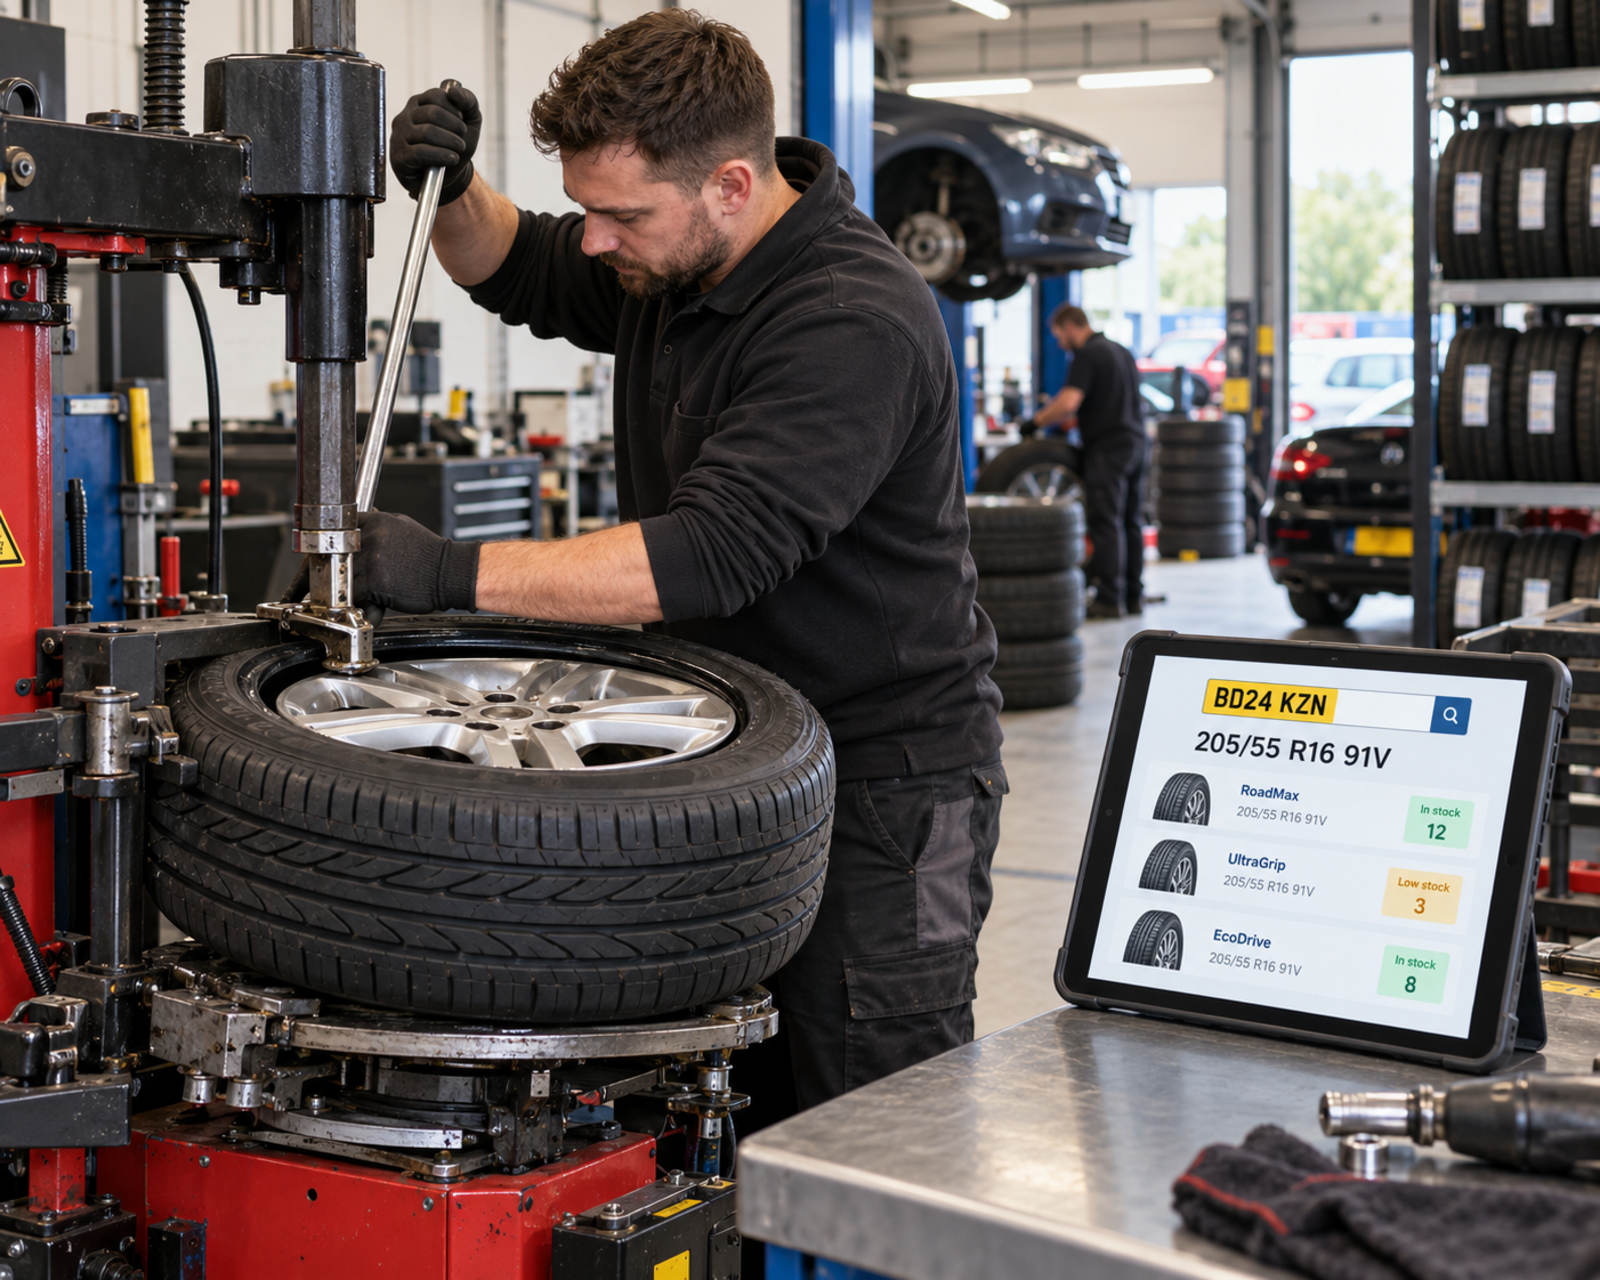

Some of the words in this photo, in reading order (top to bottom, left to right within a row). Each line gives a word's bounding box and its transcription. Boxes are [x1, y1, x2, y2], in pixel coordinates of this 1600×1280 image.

[1214, 687, 1272, 711] BD24
[1280, 692, 1327, 716] KZN
[1195, 731, 1281, 758] 205/55
[1289, 740, 1334, 763] R16
[1344, 745, 1391, 768] 91V
[1240, 785, 1299, 801] RoadMax
[1236, 806, 1276, 820] 205/55
[1279, 811, 1301, 823] R16
[1305, 814, 1327, 825] 91V
[1420, 804, 1430, 814] In
[1432, 807, 1460, 817] stock
[1427, 823, 1446, 840] 12
[1228, 853, 1285, 873] UltraGrip
[1223, 875, 1263, 890] 205/55
[1267, 881, 1288, 893] R16
[1292, 884, 1315, 897] 91V
[1397, 877, 1419, 888] Low
[1421, 882, 1449, 892] stock
[1413, 897, 1425, 914] 3
[1213, 929, 1271, 948] EcoDrive
[1208, 952, 1250, 968] 205/55
[1253, 959, 1275, 972] R16
[1278, 963, 1302, 976] 91V
[1394, 954, 1405, 965] In
[1407, 958, 1436, 969] stock
[1404, 976, 1416, 993] 8
